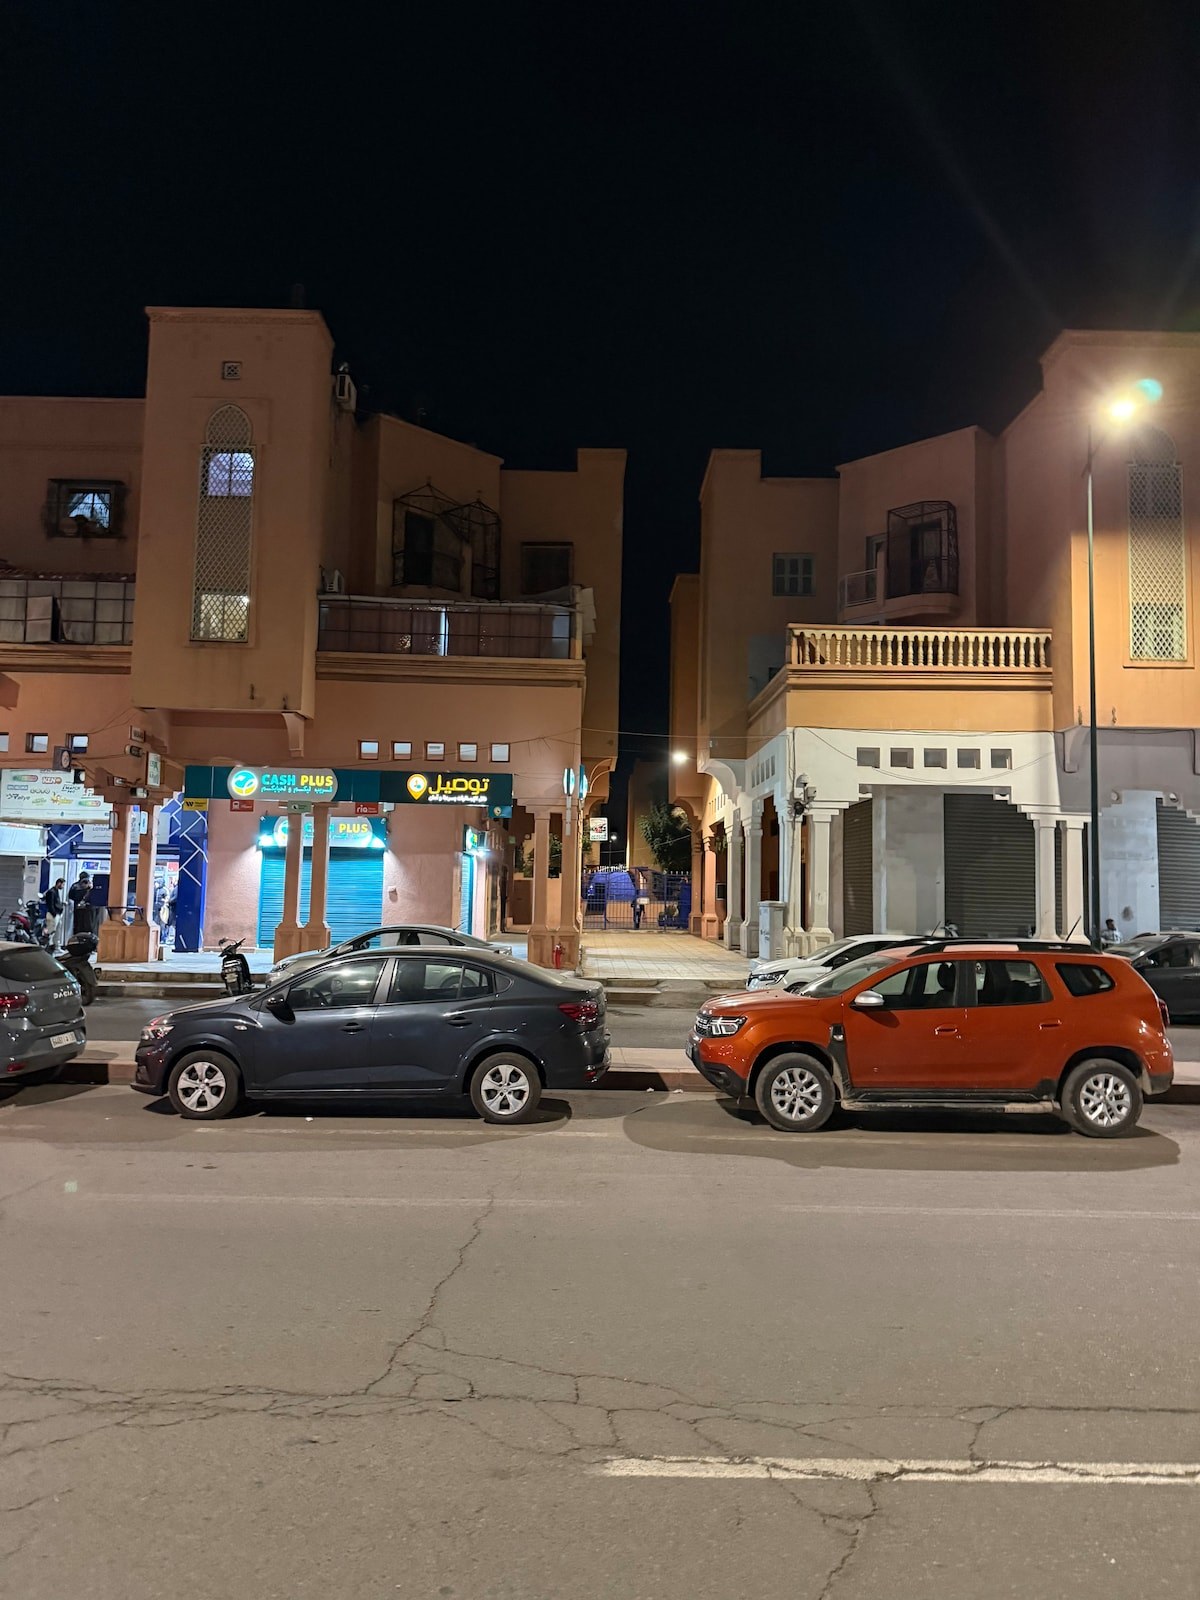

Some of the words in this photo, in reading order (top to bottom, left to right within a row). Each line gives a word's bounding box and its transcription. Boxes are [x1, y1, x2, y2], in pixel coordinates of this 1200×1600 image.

[261, 774, 296, 786] CASH
[300, 775, 334, 787] PLUS
[428, 774, 490, 795] توصيل
[356, 804, 368, 813] ria
[304, 823, 334, 833] CH
[339, 823, 368, 834] PLUS
[53, 990, 74, 999] DACIA
